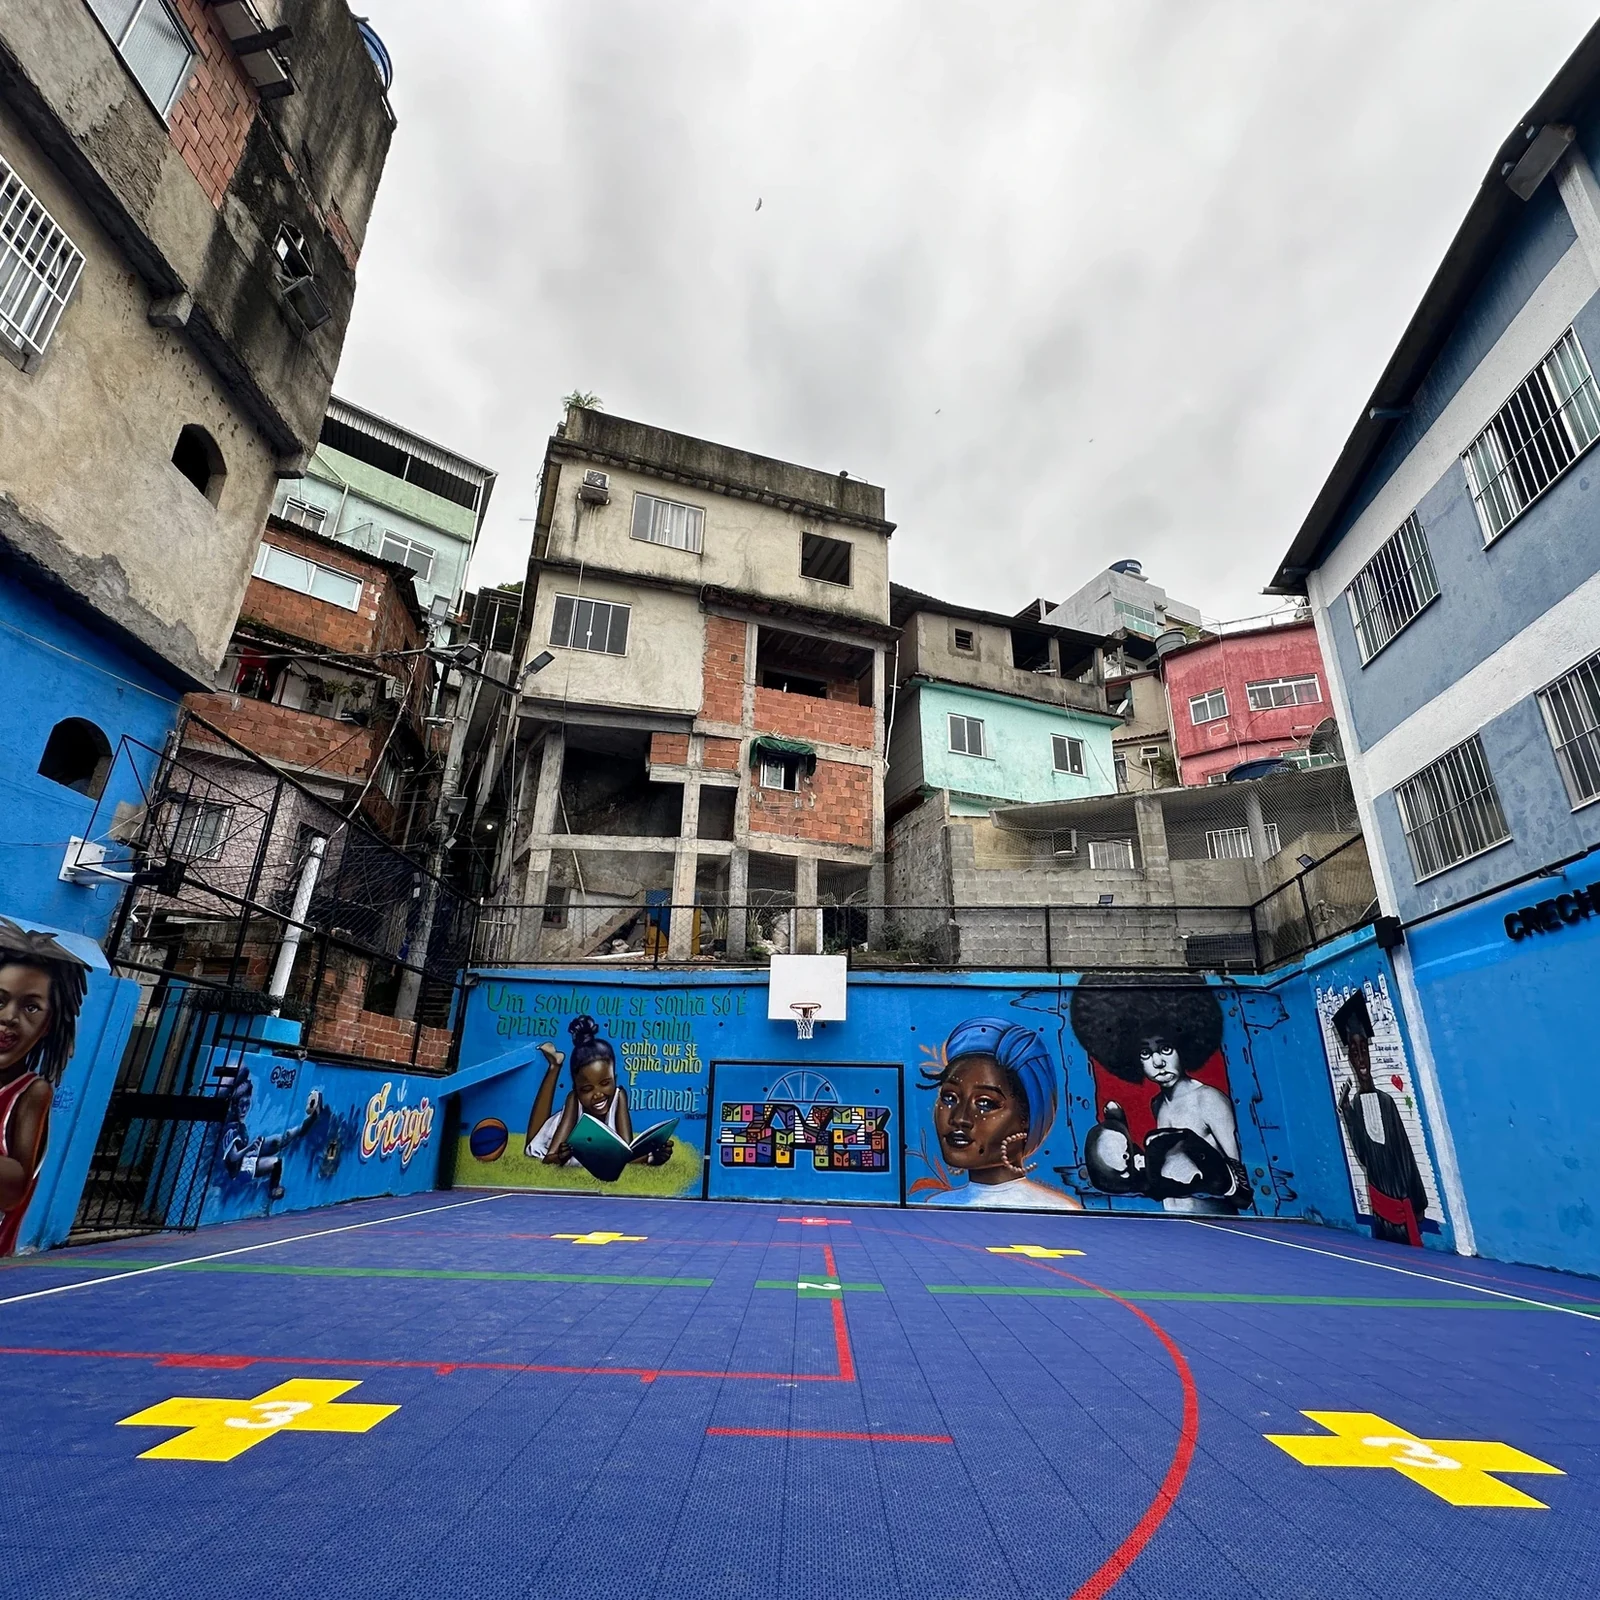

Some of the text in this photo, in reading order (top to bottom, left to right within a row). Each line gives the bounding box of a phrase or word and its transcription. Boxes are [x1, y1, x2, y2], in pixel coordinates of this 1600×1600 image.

[534, 987, 592, 1016] sonho
[655, 990, 708, 1017] sonha
[621, 1039, 657, 1057] sonho
[624, 1056, 662, 1072] sonha
[224, 1401, 313, 1429] 3
[1361, 1436, 1463, 1470] 3
